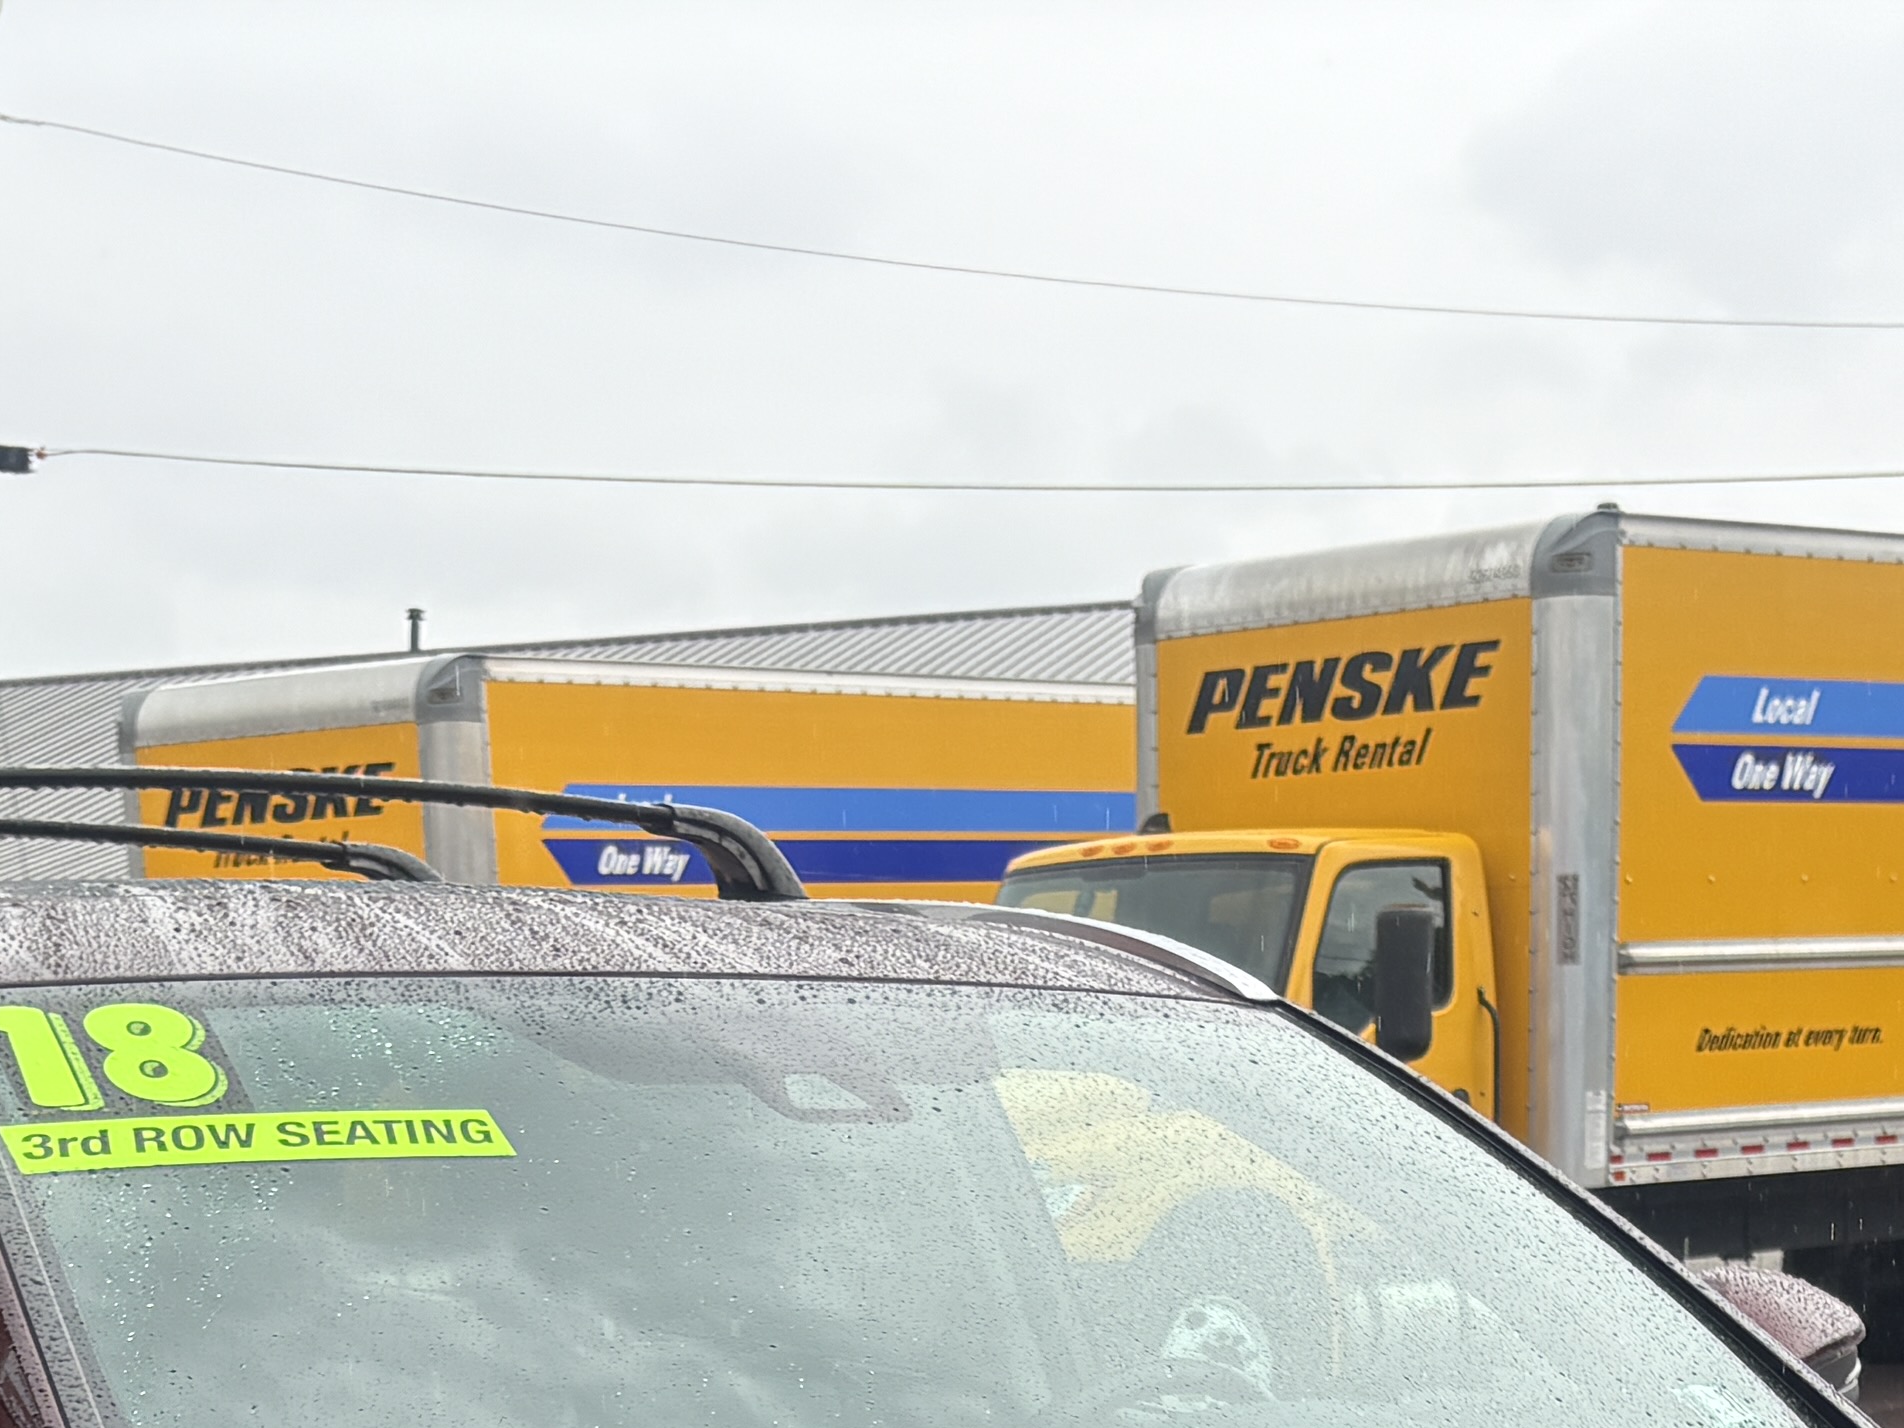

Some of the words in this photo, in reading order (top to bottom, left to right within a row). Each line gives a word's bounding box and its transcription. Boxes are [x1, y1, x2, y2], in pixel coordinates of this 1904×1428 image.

[1186, 639, 1501, 735] PENSKE
[1752, 686, 1821, 725] Local
[1250, 736, 1327, 780] Truck
[1332, 727, 1433, 773] Rental
[1731, 751, 1780, 790] One
[1781, 751, 1836, 799] Way
[598, 845, 641, 875] One
[642, 846, 691, 882] Way
[1696, 1026, 1783, 1052] Dedication
[1784, 1027, 1803, 1047] at
[1804, 1028, 1848, 1051] every
[21, 1129, 112, 1160] 3rd
[133, 1122, 256, 1153] ROW
[277, 1118, 494, 1147] SEATING
